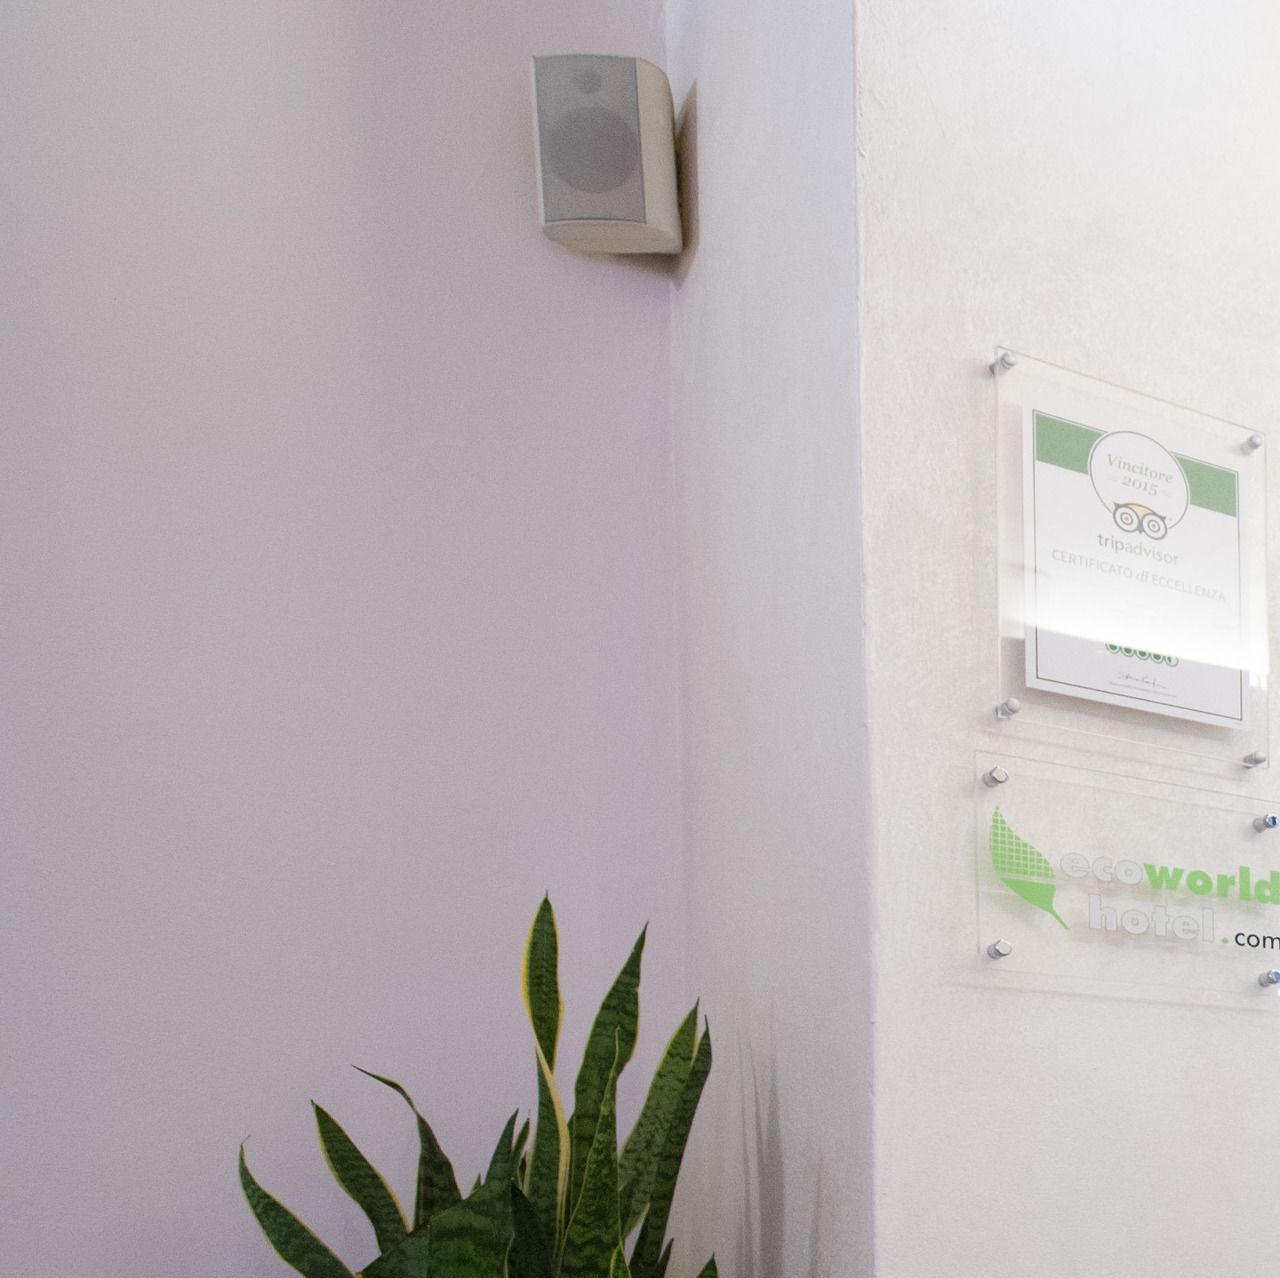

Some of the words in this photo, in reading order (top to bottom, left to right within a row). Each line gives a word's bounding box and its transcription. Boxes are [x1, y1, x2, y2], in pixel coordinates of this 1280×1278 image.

[1107, 454, 1173, 483] Vincitore
[1121, 475, 1159, 497] 2015
[1097, 532, 1180, 566] tripadvisor
[1052, 550, 1133, 579] CERTIFICATO
[1135, 569, 1149, 583] di
[1152, 576, 1226, 601] ECCELLENZA
